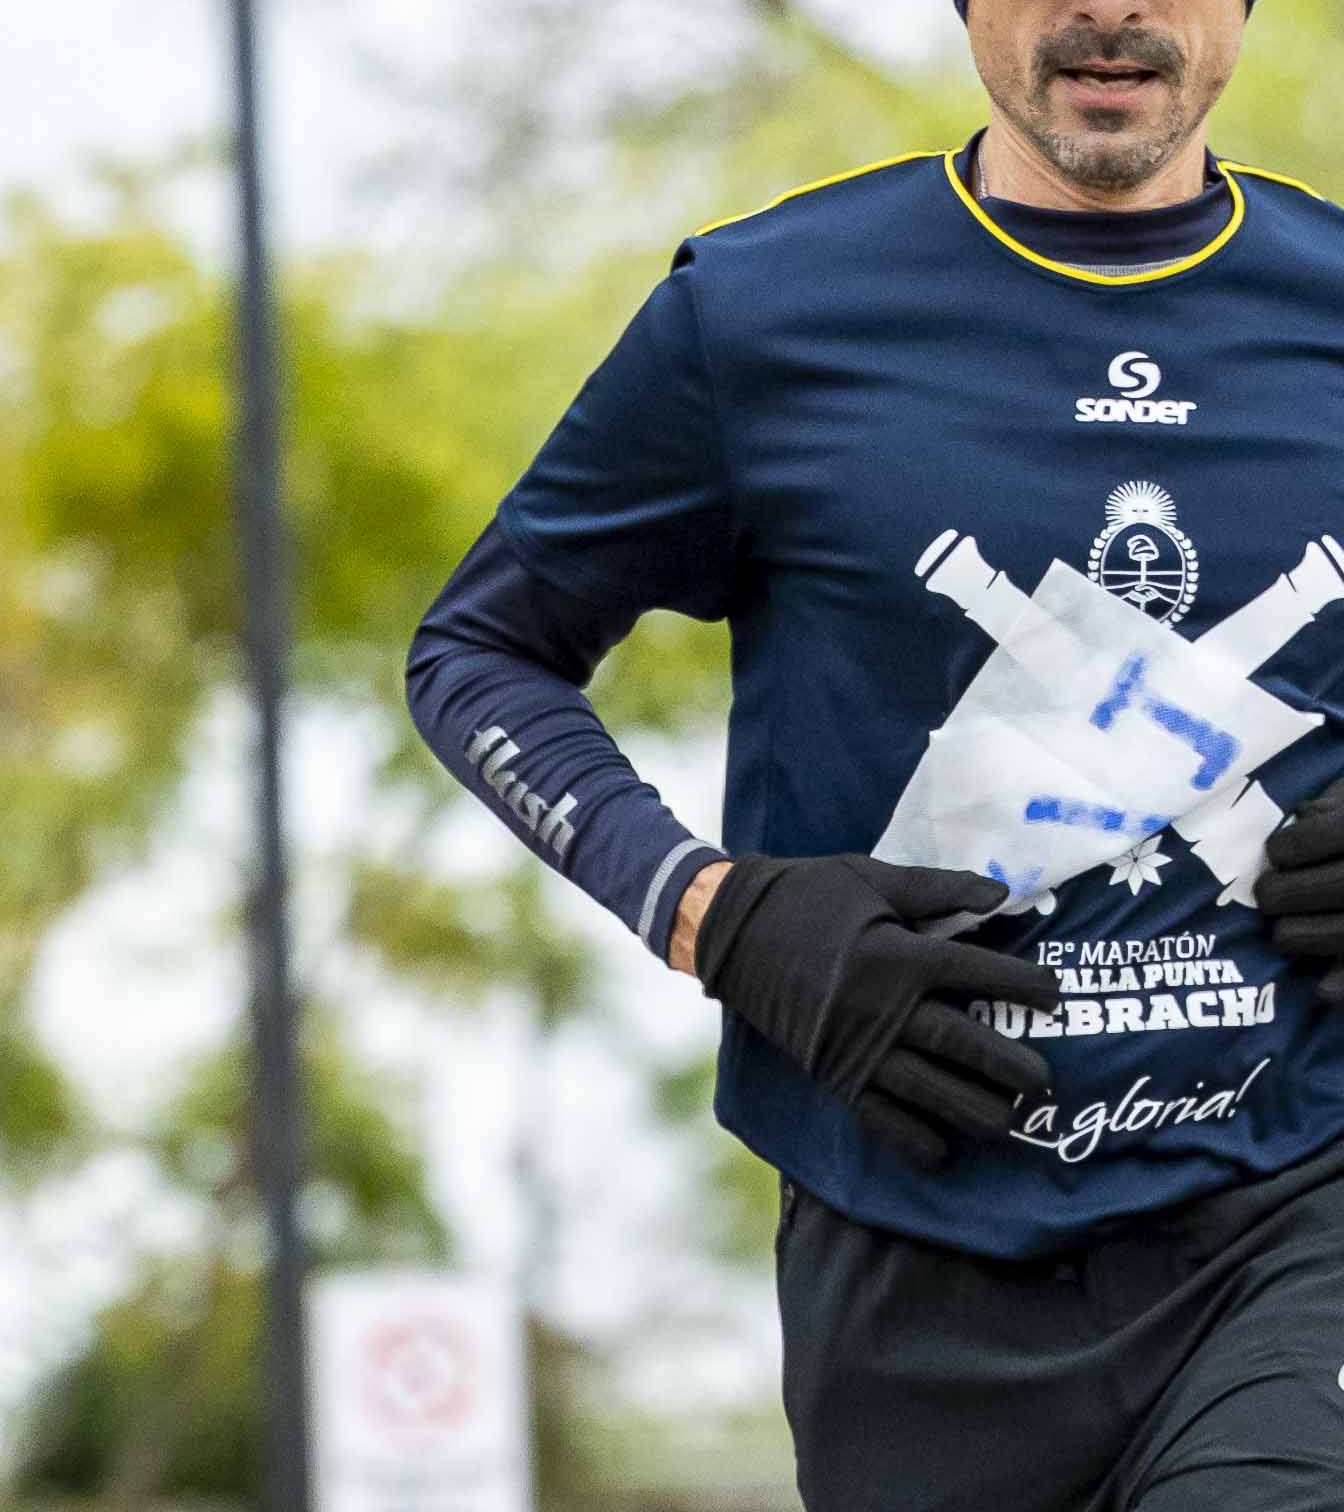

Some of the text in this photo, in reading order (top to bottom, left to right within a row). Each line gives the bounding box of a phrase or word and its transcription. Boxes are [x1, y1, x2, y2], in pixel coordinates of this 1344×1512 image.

[1078, 931, 1217, 967] MARATÓN
[1054, 959, 1244, 994] ALLA PUNTA
